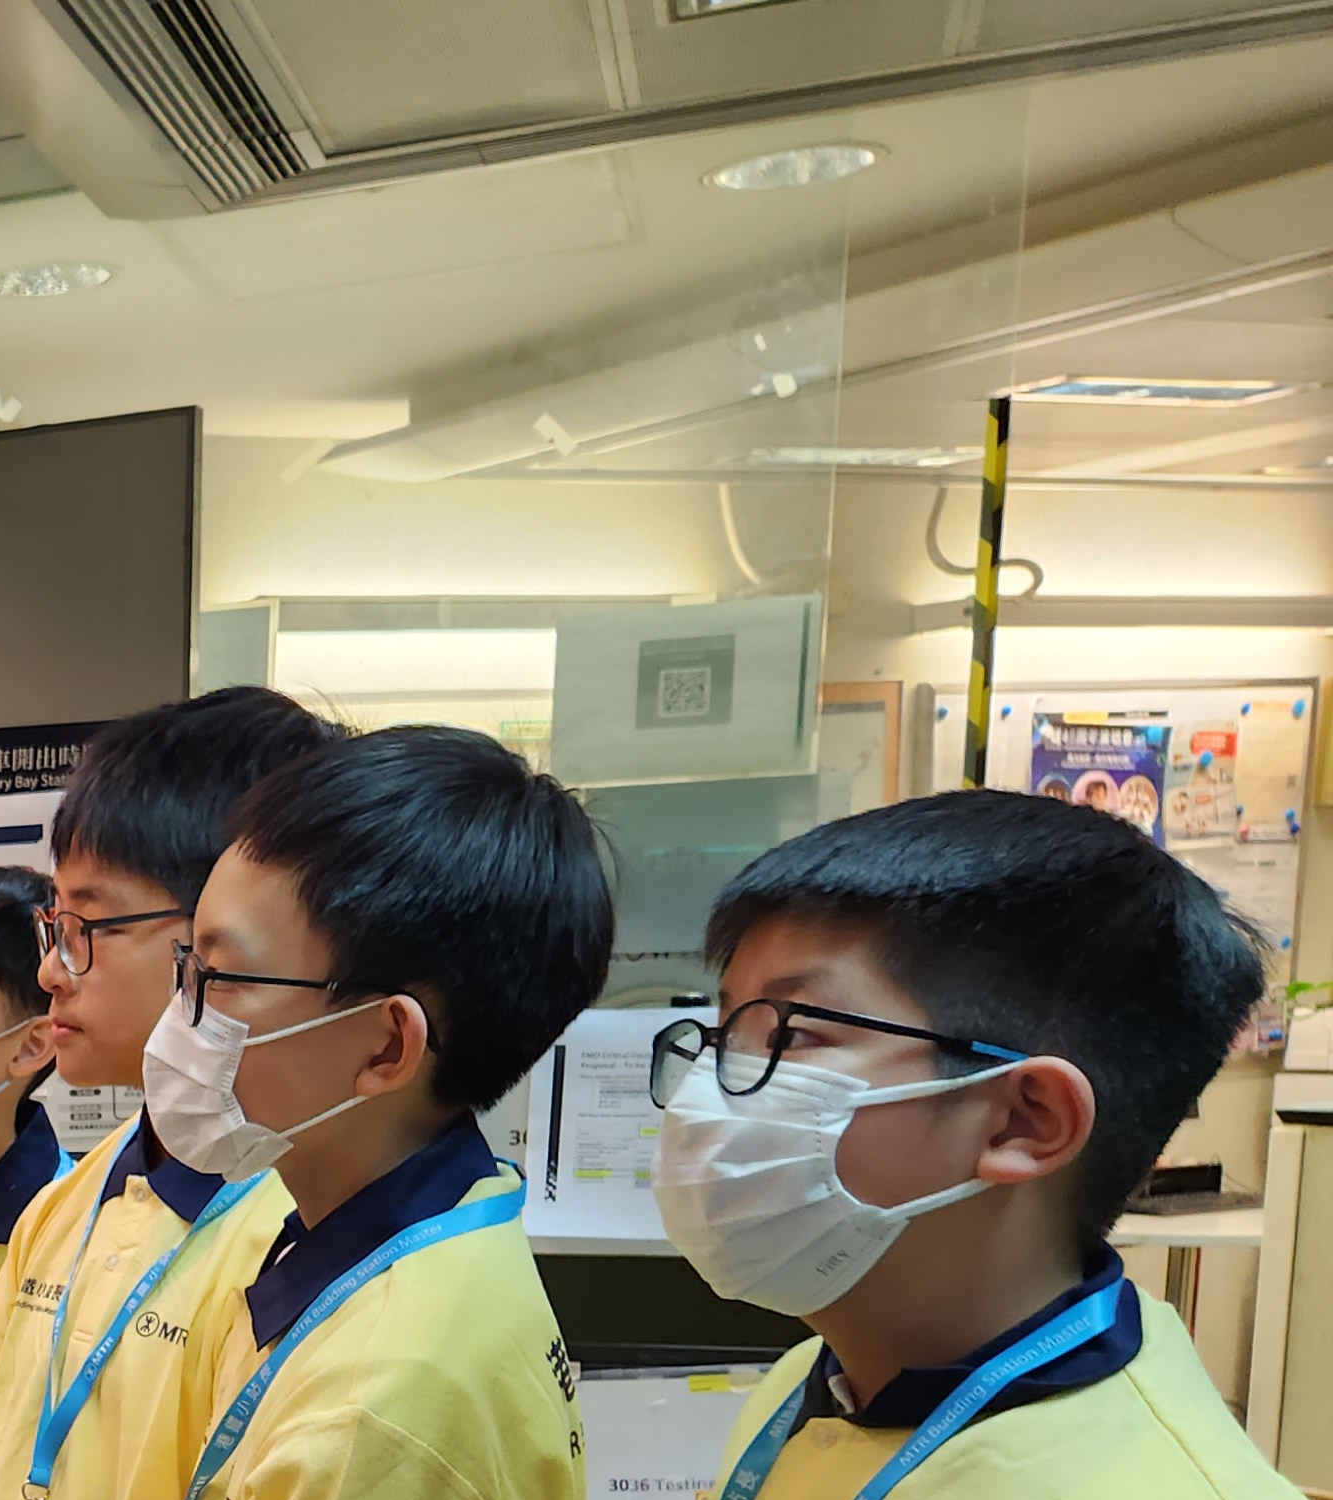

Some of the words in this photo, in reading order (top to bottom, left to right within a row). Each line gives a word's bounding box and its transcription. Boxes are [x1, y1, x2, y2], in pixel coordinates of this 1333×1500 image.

[14, 774, 37, 790] Bay
[40, 773, 67, 787] Stat
[290, 1314, 313, 1343] MTR
[311, 1274, 358, 1319] Budding
[355, 1245, 400, 1280] Station
[397, 1223, 444, 1249] Master
[158, 1321, 189, 1349] MR
[92, 1336, 115, 1367] MTR
[896, 1434, 930, 1468] MTR
[926, 1384, 986, 1440] Budding
[981, 1346, 1041, 1400] Station
[1036, 1313, 1094, 1359] Master
[608, 1478, 650, 1492] 3036
